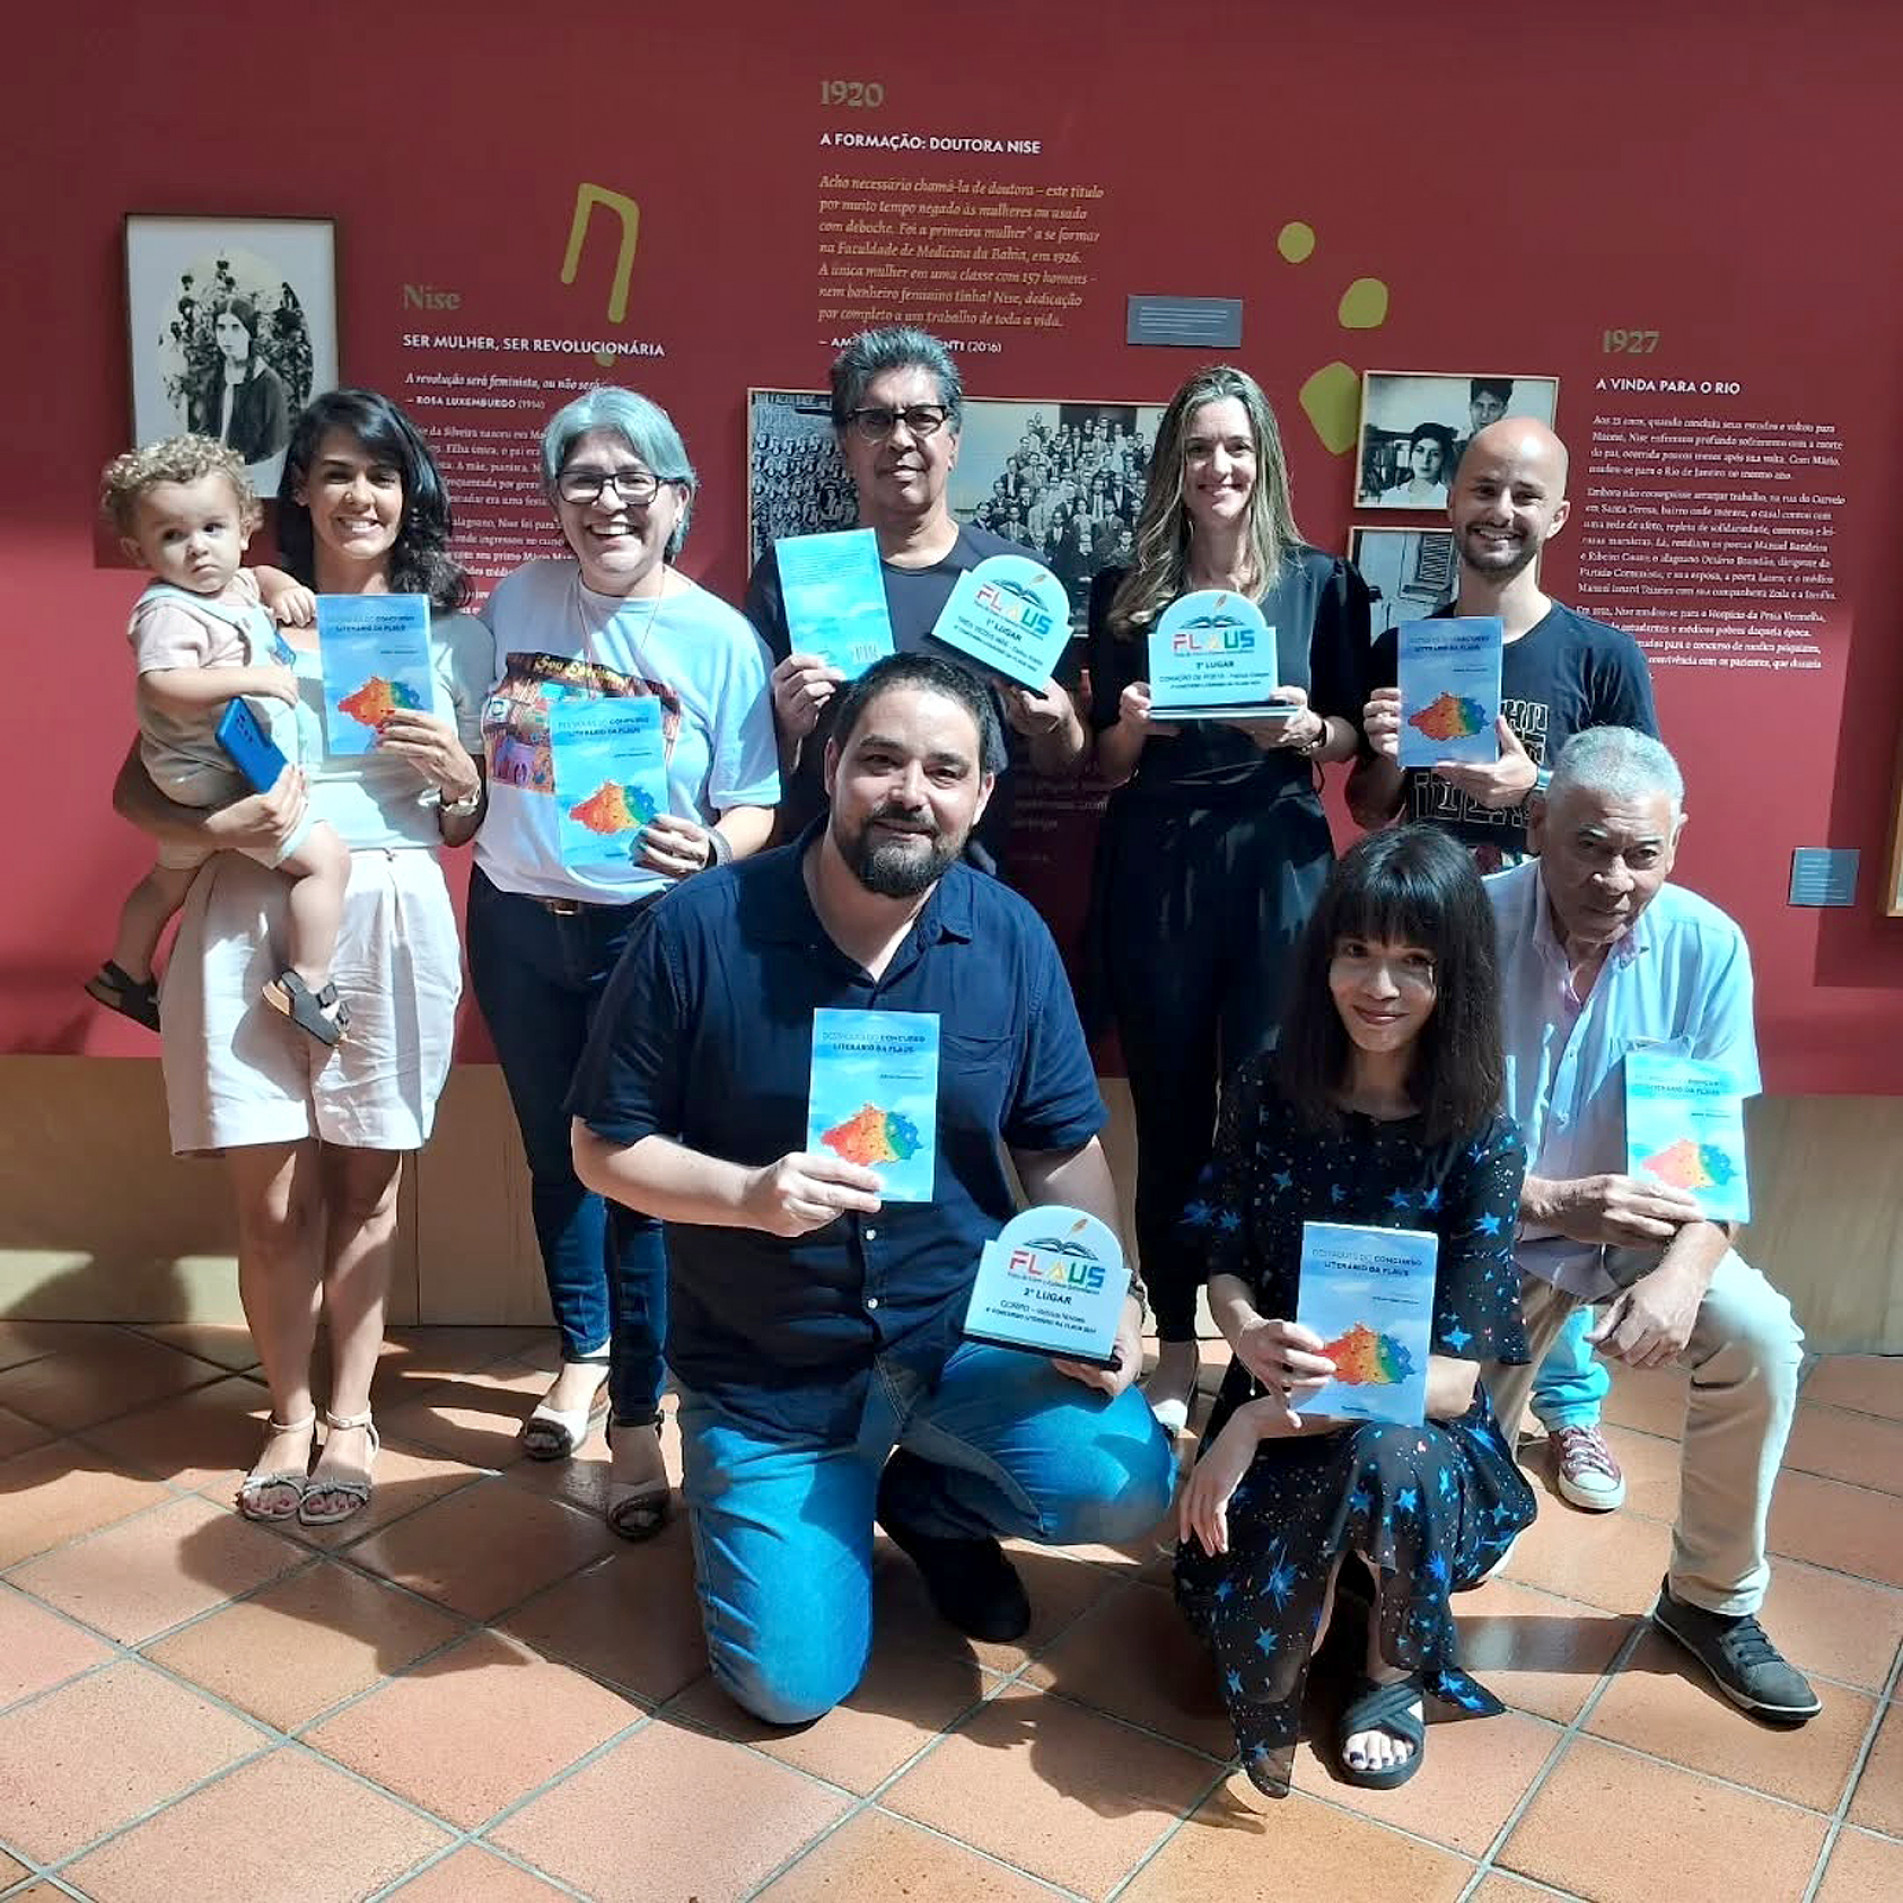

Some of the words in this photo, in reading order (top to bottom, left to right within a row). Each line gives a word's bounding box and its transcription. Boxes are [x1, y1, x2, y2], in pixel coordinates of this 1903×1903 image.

[820, 80, 885, 108] 1920
[820, 133, 832, 145] A
[834, 134, 926, 150] FORMAÇÃO:
[929, 137, 1004, 150] DOUTORA
[1006, 139, 1040, 152] NISE
[819, 175, 850, 189] Acho
[971, 180, 986, 194] de
[1045, 182, 1068, 197] este
[819, 199, 840, 213] por
[878, 198, 916, 216] tempo
[918, 199, 961, 218] negado
[978, 201, 1032, 217] mulheres
[818, 222, 843, 232] com
[898, 220, 917, 234] Foi
[928, 225, 982, 240] primeira
[1058, 225, 1100, 243] formar
[836, 240, 898, 256] Faculdade
[900, 242, 914, 256] de
[916, 243, 971, 258] Medicina
[818, 262, 828, 276] A
[865, 263, 909, 278] mulher
[910, 269, 928, 279] em
[959, 266, 994, 281] classe
[404, 285, 461, 310] Nise
[818, 308, 838, 322] por
[978, 310, 993, 324] de
[403, 336, 430, 348] SER
[502, 339, 529, 351] SER
[533, 340, 664, 355] REVOLUCIONÁRIA
[1603, 330, 1659, 353] 1927
[1596, 378, 1606, 390] A
[1610, 378, 1656, 392] VINDA
[1659, 380, 1696, 393] PARA
[1700, 382, 1712, 393] O
[1714, 382, 1740, 394] RIO
[977, 584, 1053, 635] FLAUS
[1173, 629, 1255, 650] FLAUS
[1009, 1250, 1106, 1288] FLAUS
[1036, 1290, 1073, 1305] LUGAR
